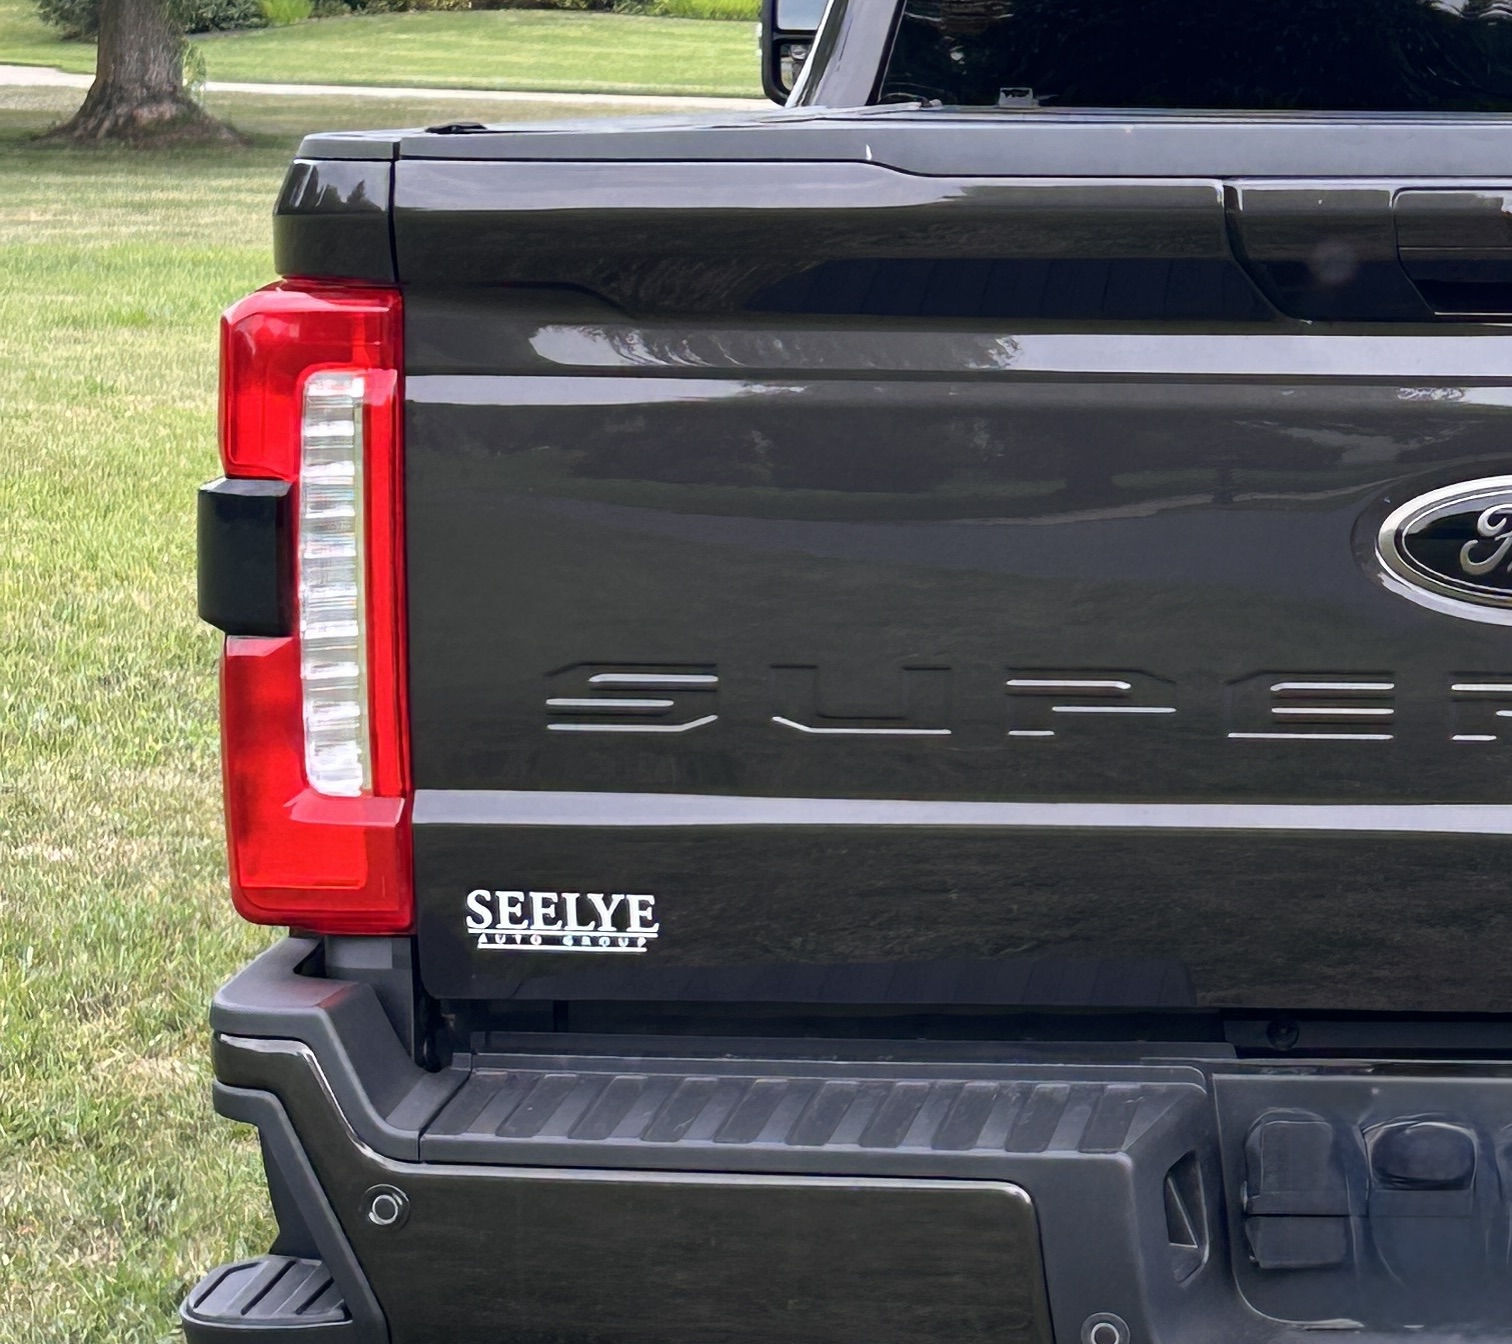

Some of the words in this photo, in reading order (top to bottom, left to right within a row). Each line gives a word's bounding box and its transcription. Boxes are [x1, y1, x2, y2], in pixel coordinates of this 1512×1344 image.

[465, 889, 660, 932] SEELYE
[478, 933, 543, 945] AUTO
[562, 935, 647, 947] GROUP
